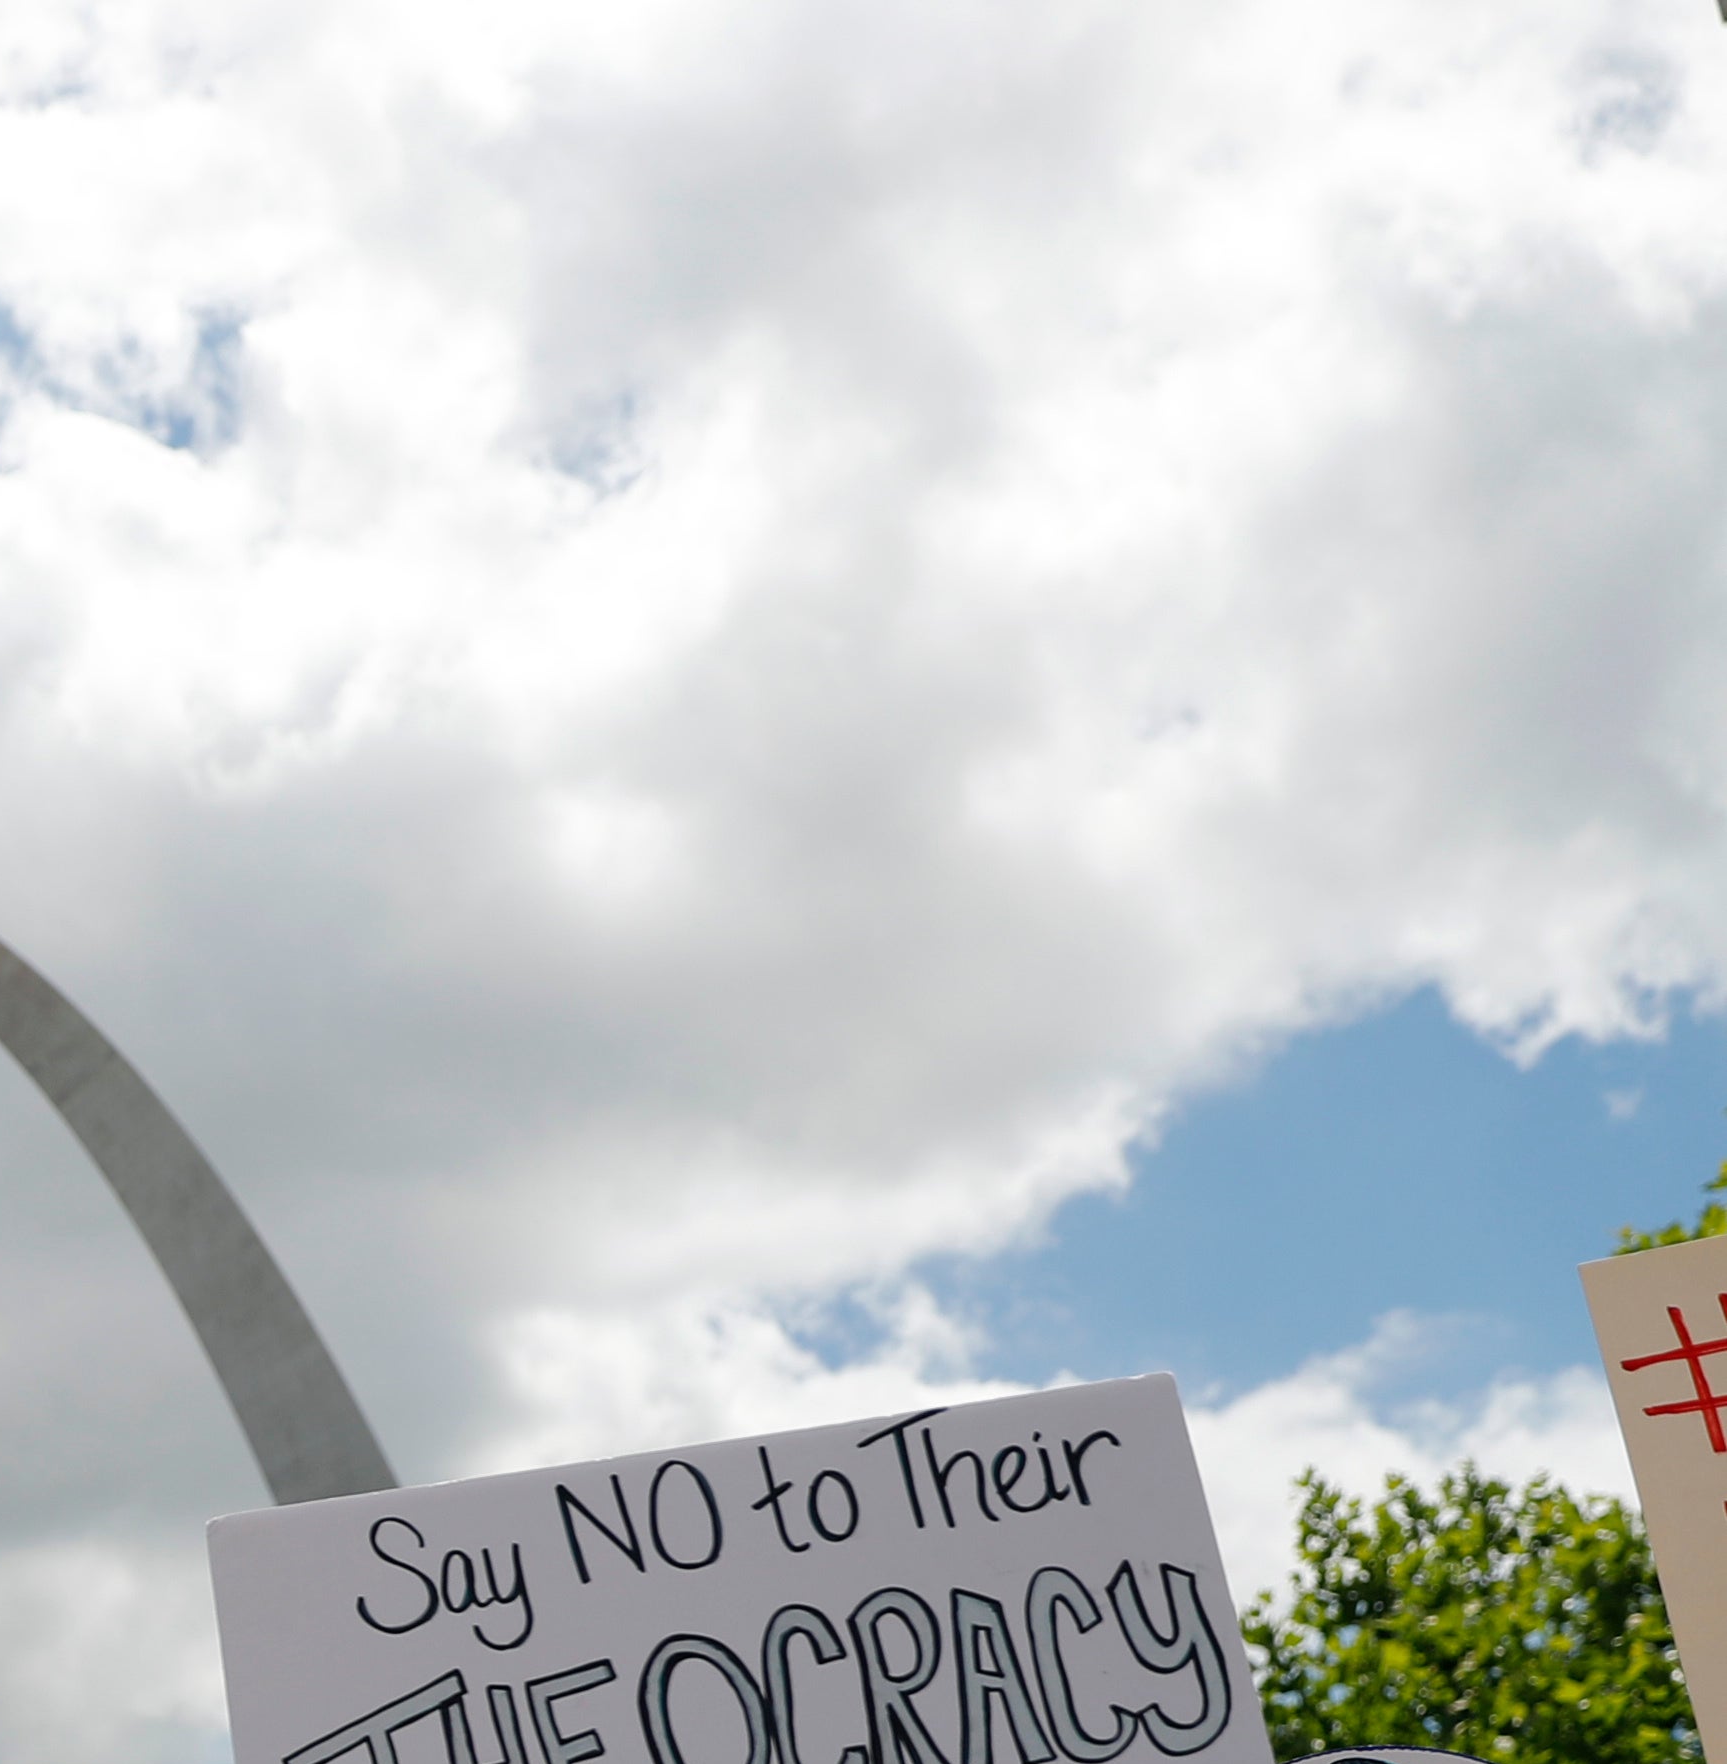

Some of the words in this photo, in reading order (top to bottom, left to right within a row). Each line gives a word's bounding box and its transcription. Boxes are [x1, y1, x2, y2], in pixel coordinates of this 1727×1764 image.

[356, 1514, 535, 1652] Say
[554, 1458, 724, 1585] NO
[751, 1444, 861, 1554] to
[857, 1406, 1122, 1531] Their
